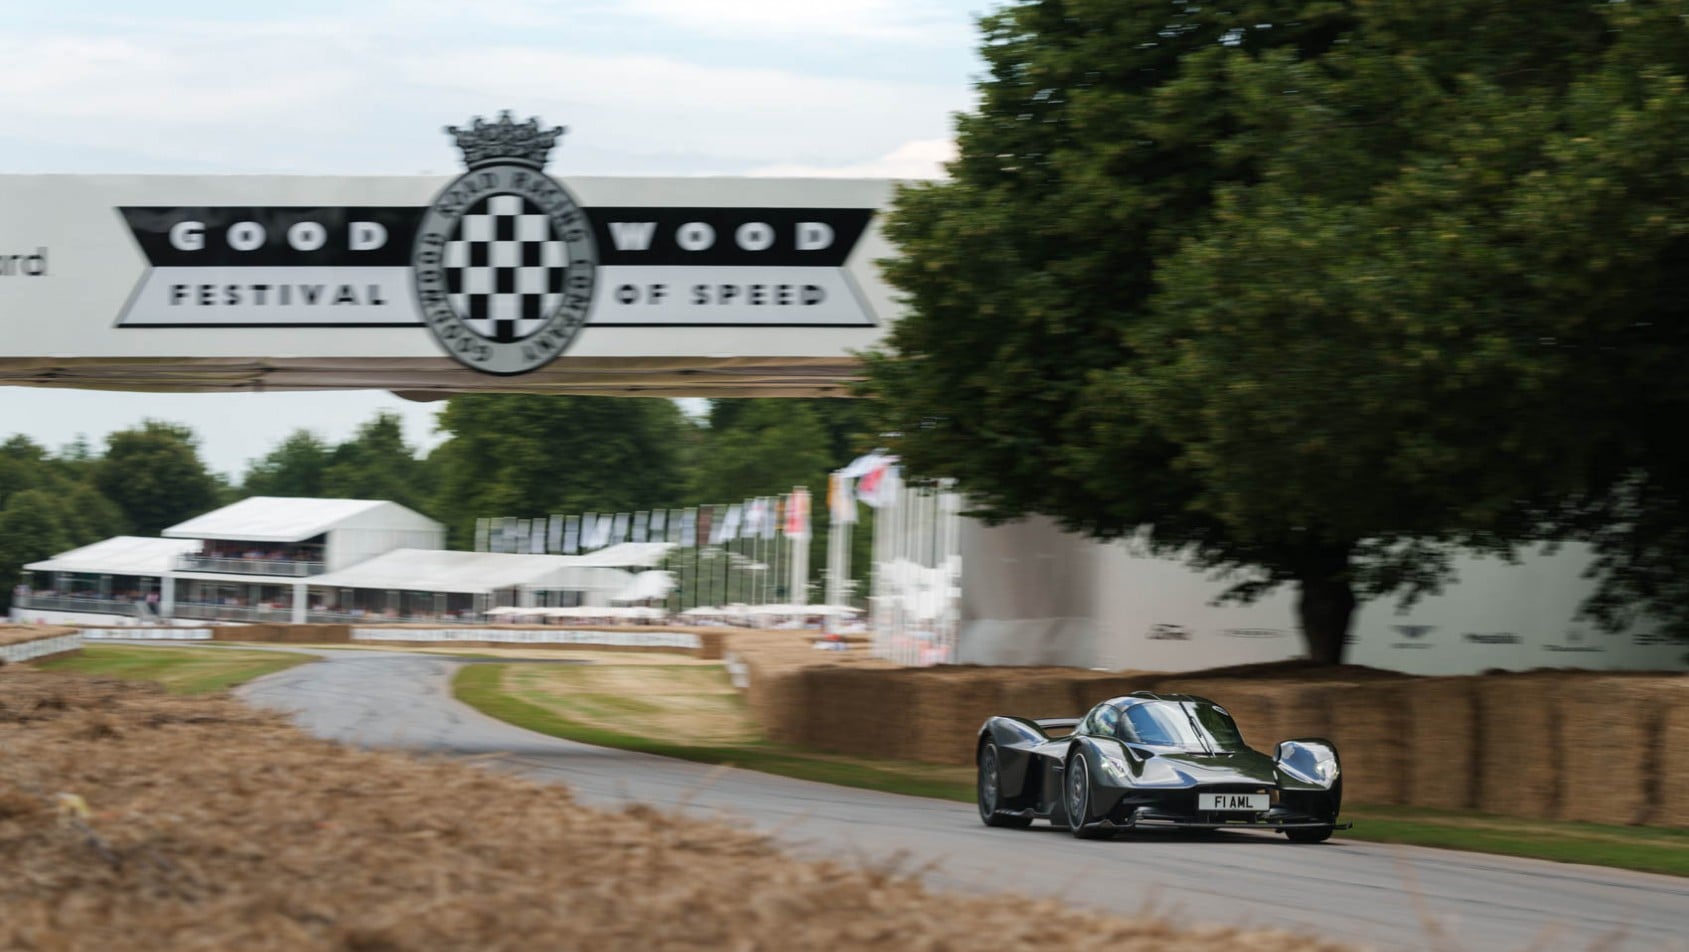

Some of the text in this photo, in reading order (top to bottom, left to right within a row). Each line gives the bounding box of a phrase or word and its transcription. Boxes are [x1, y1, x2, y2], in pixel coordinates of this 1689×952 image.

[168, 221, 836, 251] GOOD WOOD
[170, 283, 828, 306] FESTIVAL OF SPEED
[1214, 795, 1254, 809] F1 AML
